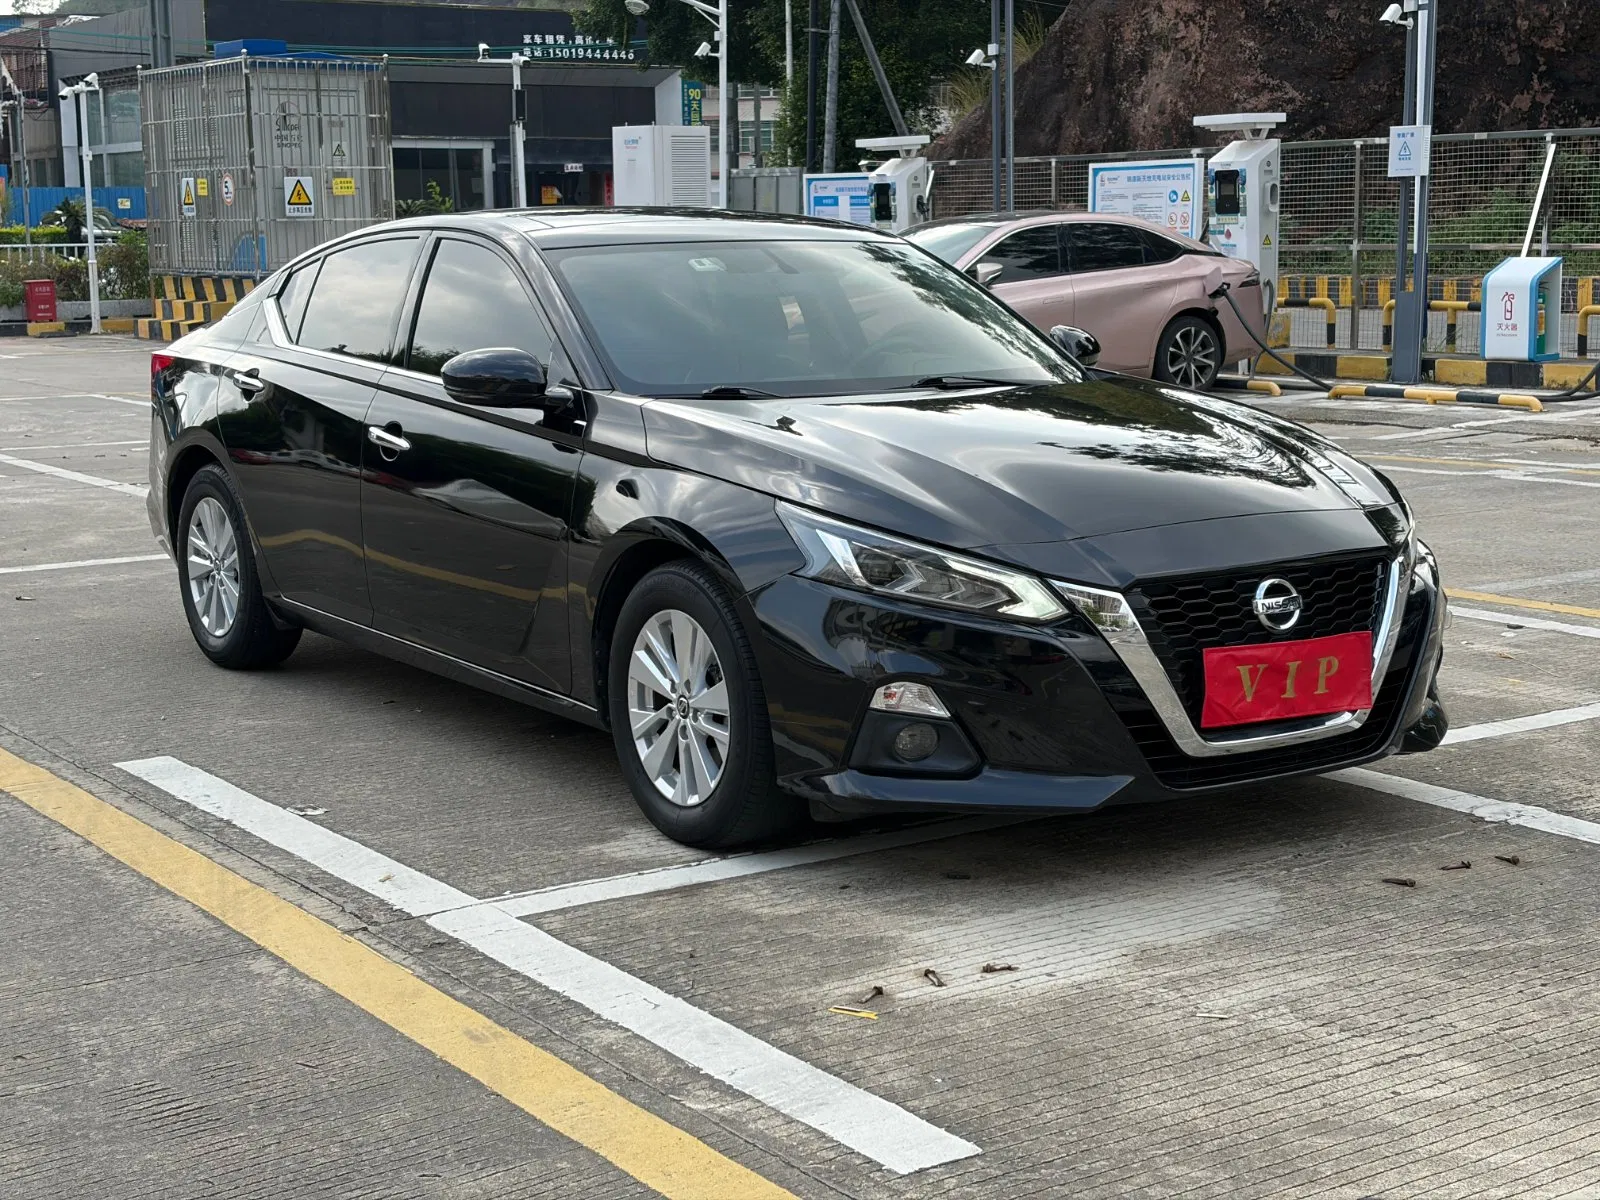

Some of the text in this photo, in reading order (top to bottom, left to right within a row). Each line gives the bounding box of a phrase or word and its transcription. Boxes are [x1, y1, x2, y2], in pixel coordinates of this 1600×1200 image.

[1496, 322, 1518, 331] 灭火器
[1260, 596, 1300, 612] NISSAN
[1236, 655, 1339, 703] VIP
